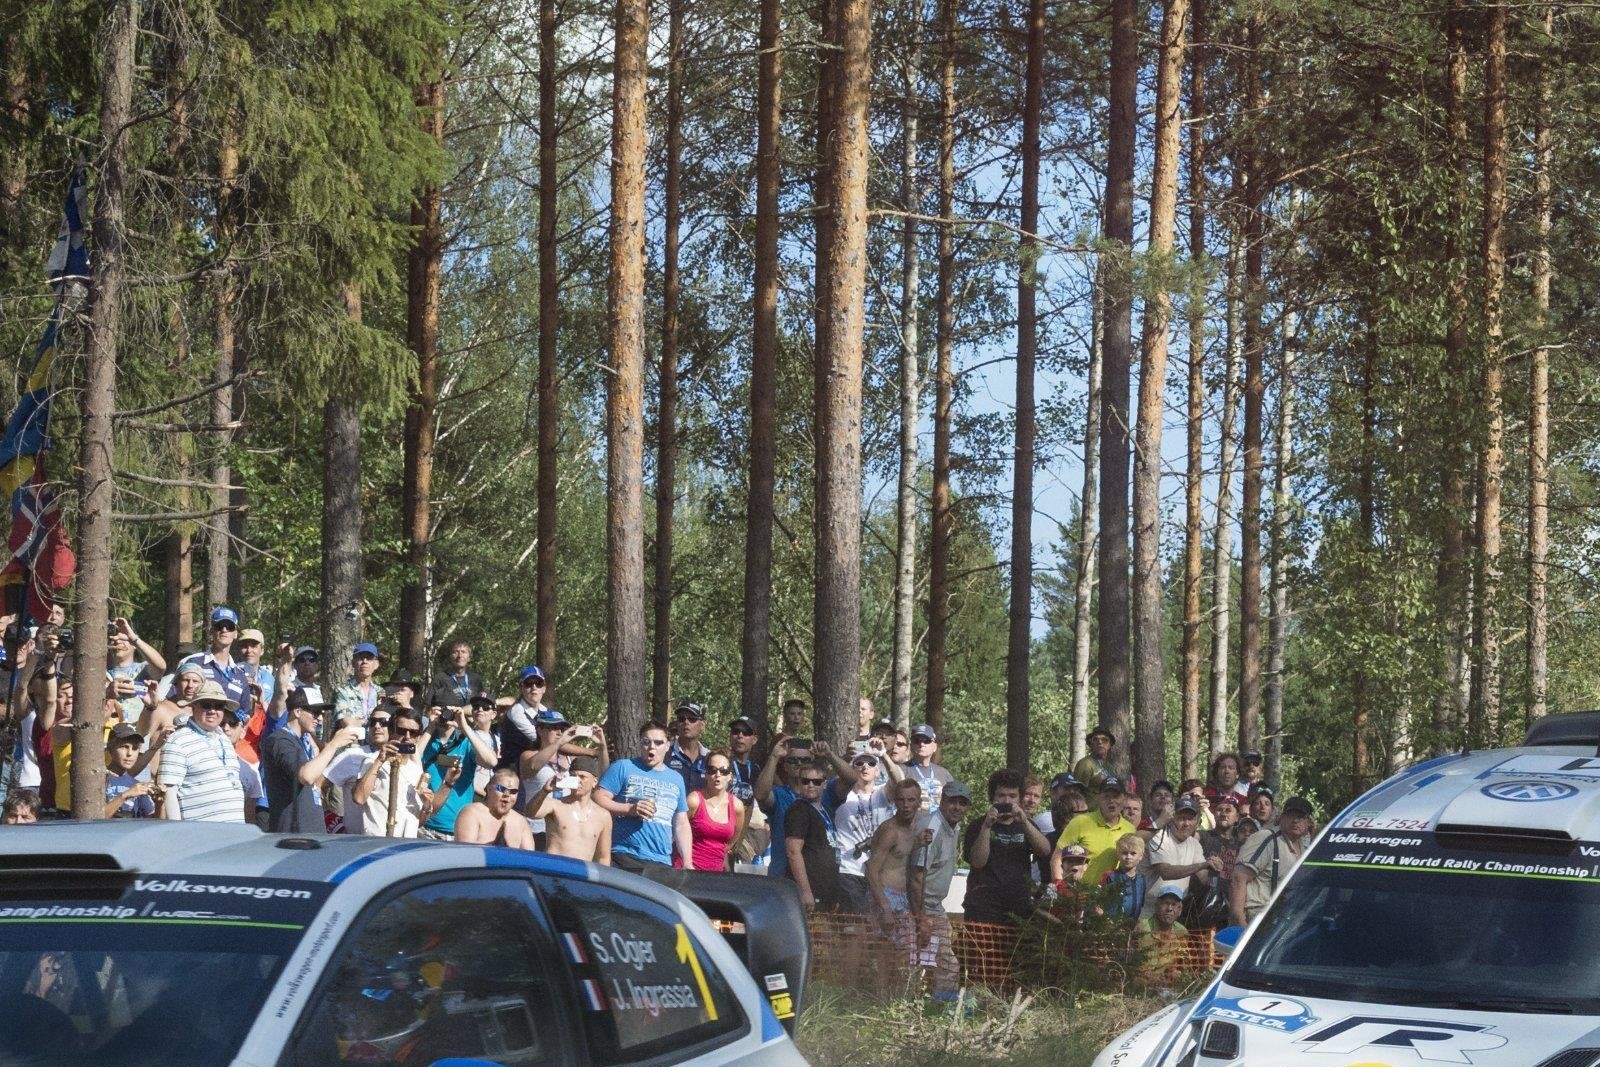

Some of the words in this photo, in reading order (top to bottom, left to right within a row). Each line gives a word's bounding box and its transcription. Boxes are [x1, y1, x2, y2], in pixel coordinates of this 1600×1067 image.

[1328, 833, 1423, 847] Volkswagen
[1372, 855, 1395, 865] FIA
[1399, 856, 1440, 868] World
[1444, 858, 1481, 871] Rally
[1484, 861, 1589, 878] Championship
[134, 879, 312, 899] Volkswagen
[0, 905, 137, 918] ampionship
[589, 932, 616, 964] S.
[611, 933, 657, 971] Ogier
[675, 923, 719, 1021] 1
[626, 977, 698, 1016] Ingrassia
[1261, 1001, 1282, 1011] 1
[1205, 1007, 1266, 1023] NESTE
